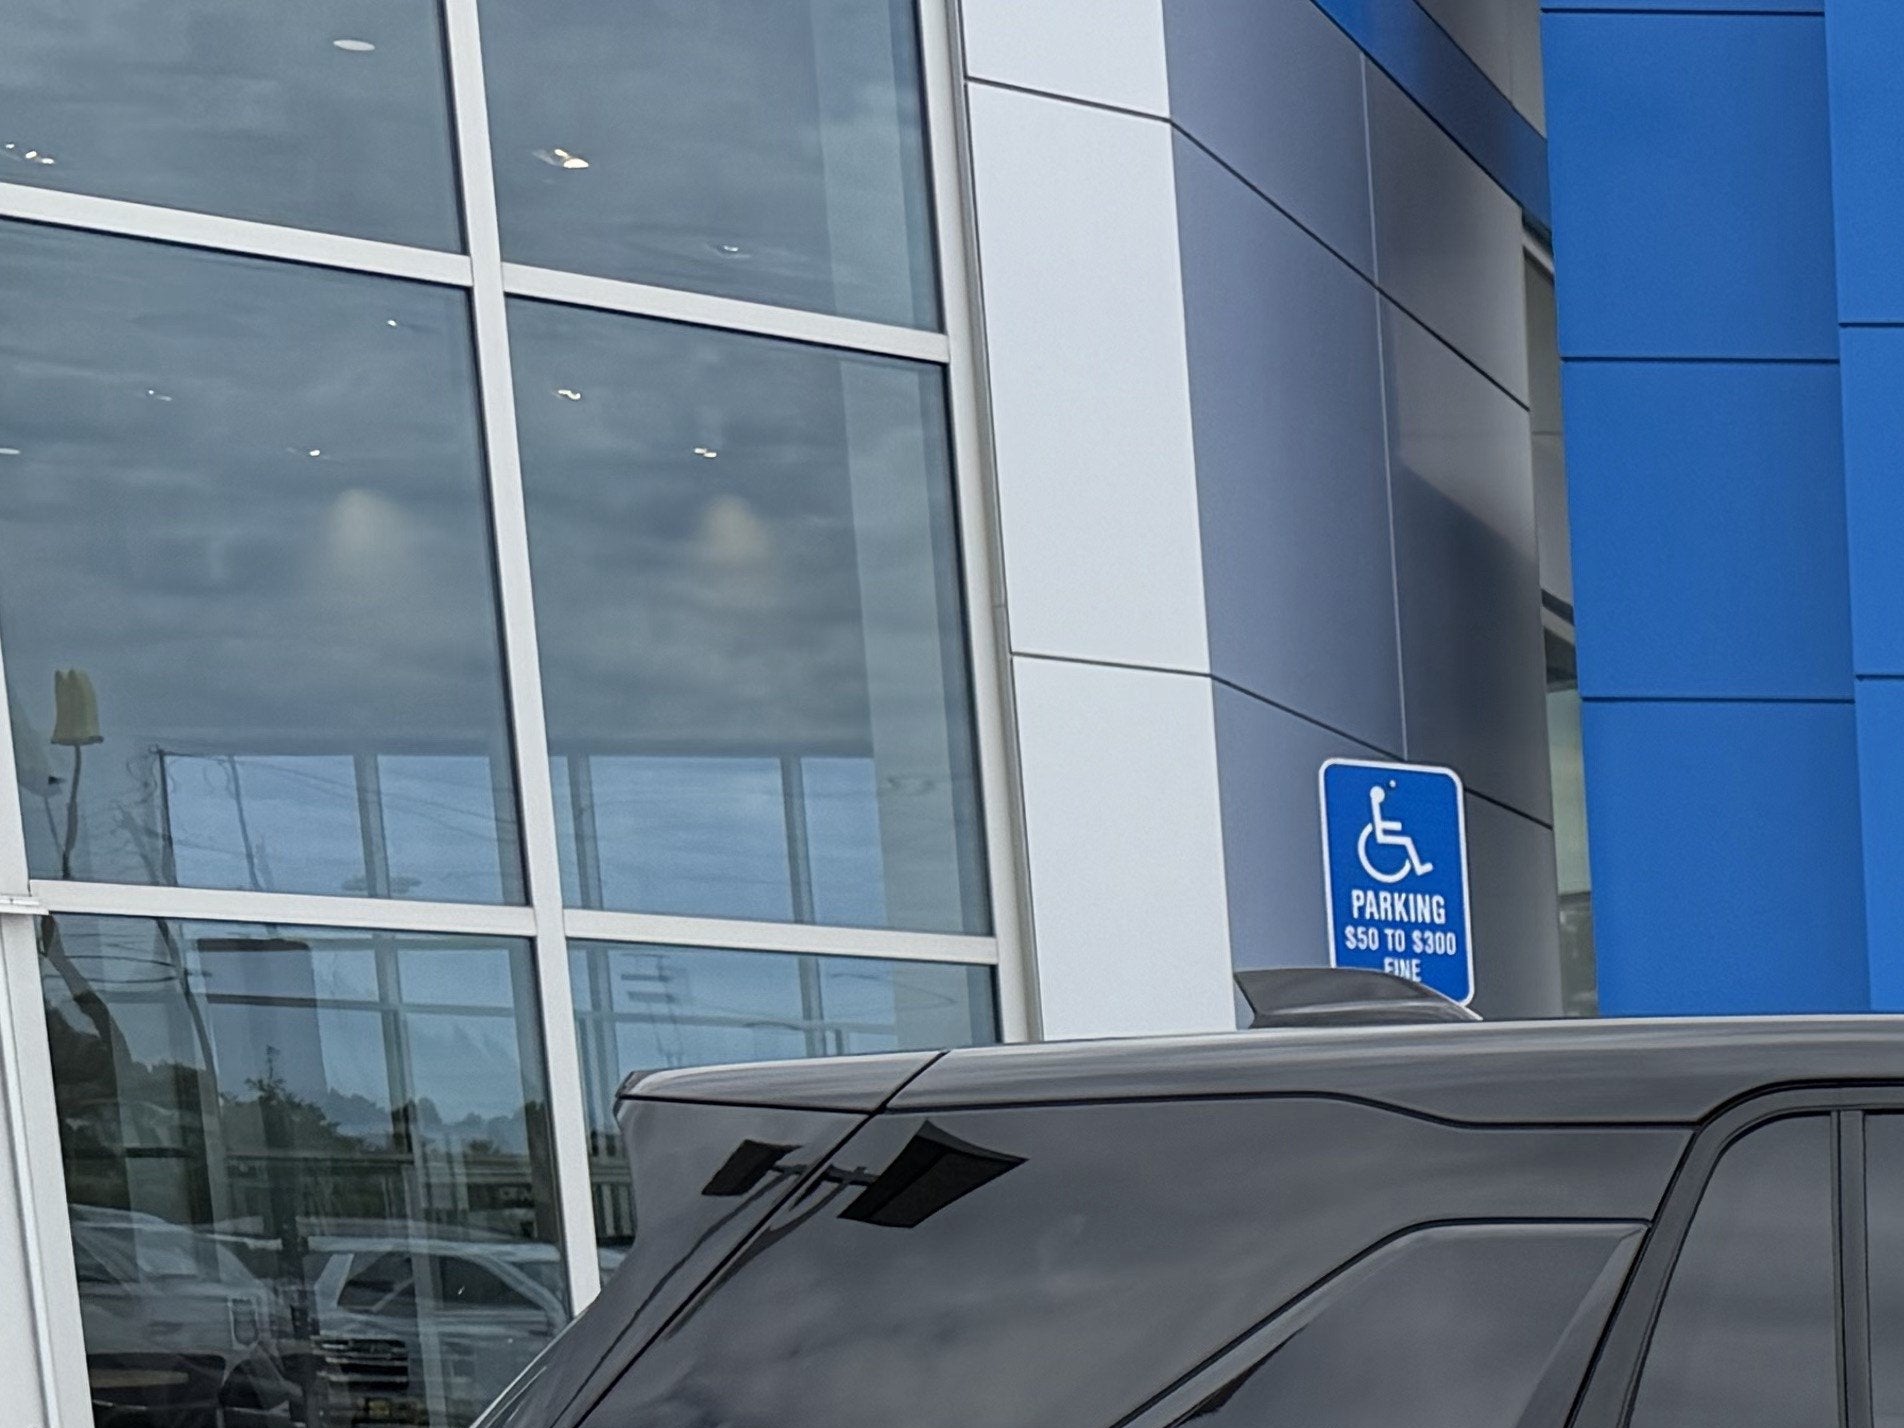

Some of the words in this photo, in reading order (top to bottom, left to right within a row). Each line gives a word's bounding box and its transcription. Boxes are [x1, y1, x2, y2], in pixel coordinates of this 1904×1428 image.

[1351, 889, 1446, 923] PARKING
[1344, 925, 1379, 951] $50
[1384, 928, 1405, 952] TO
[1411, 929, 1456, 956] $300
